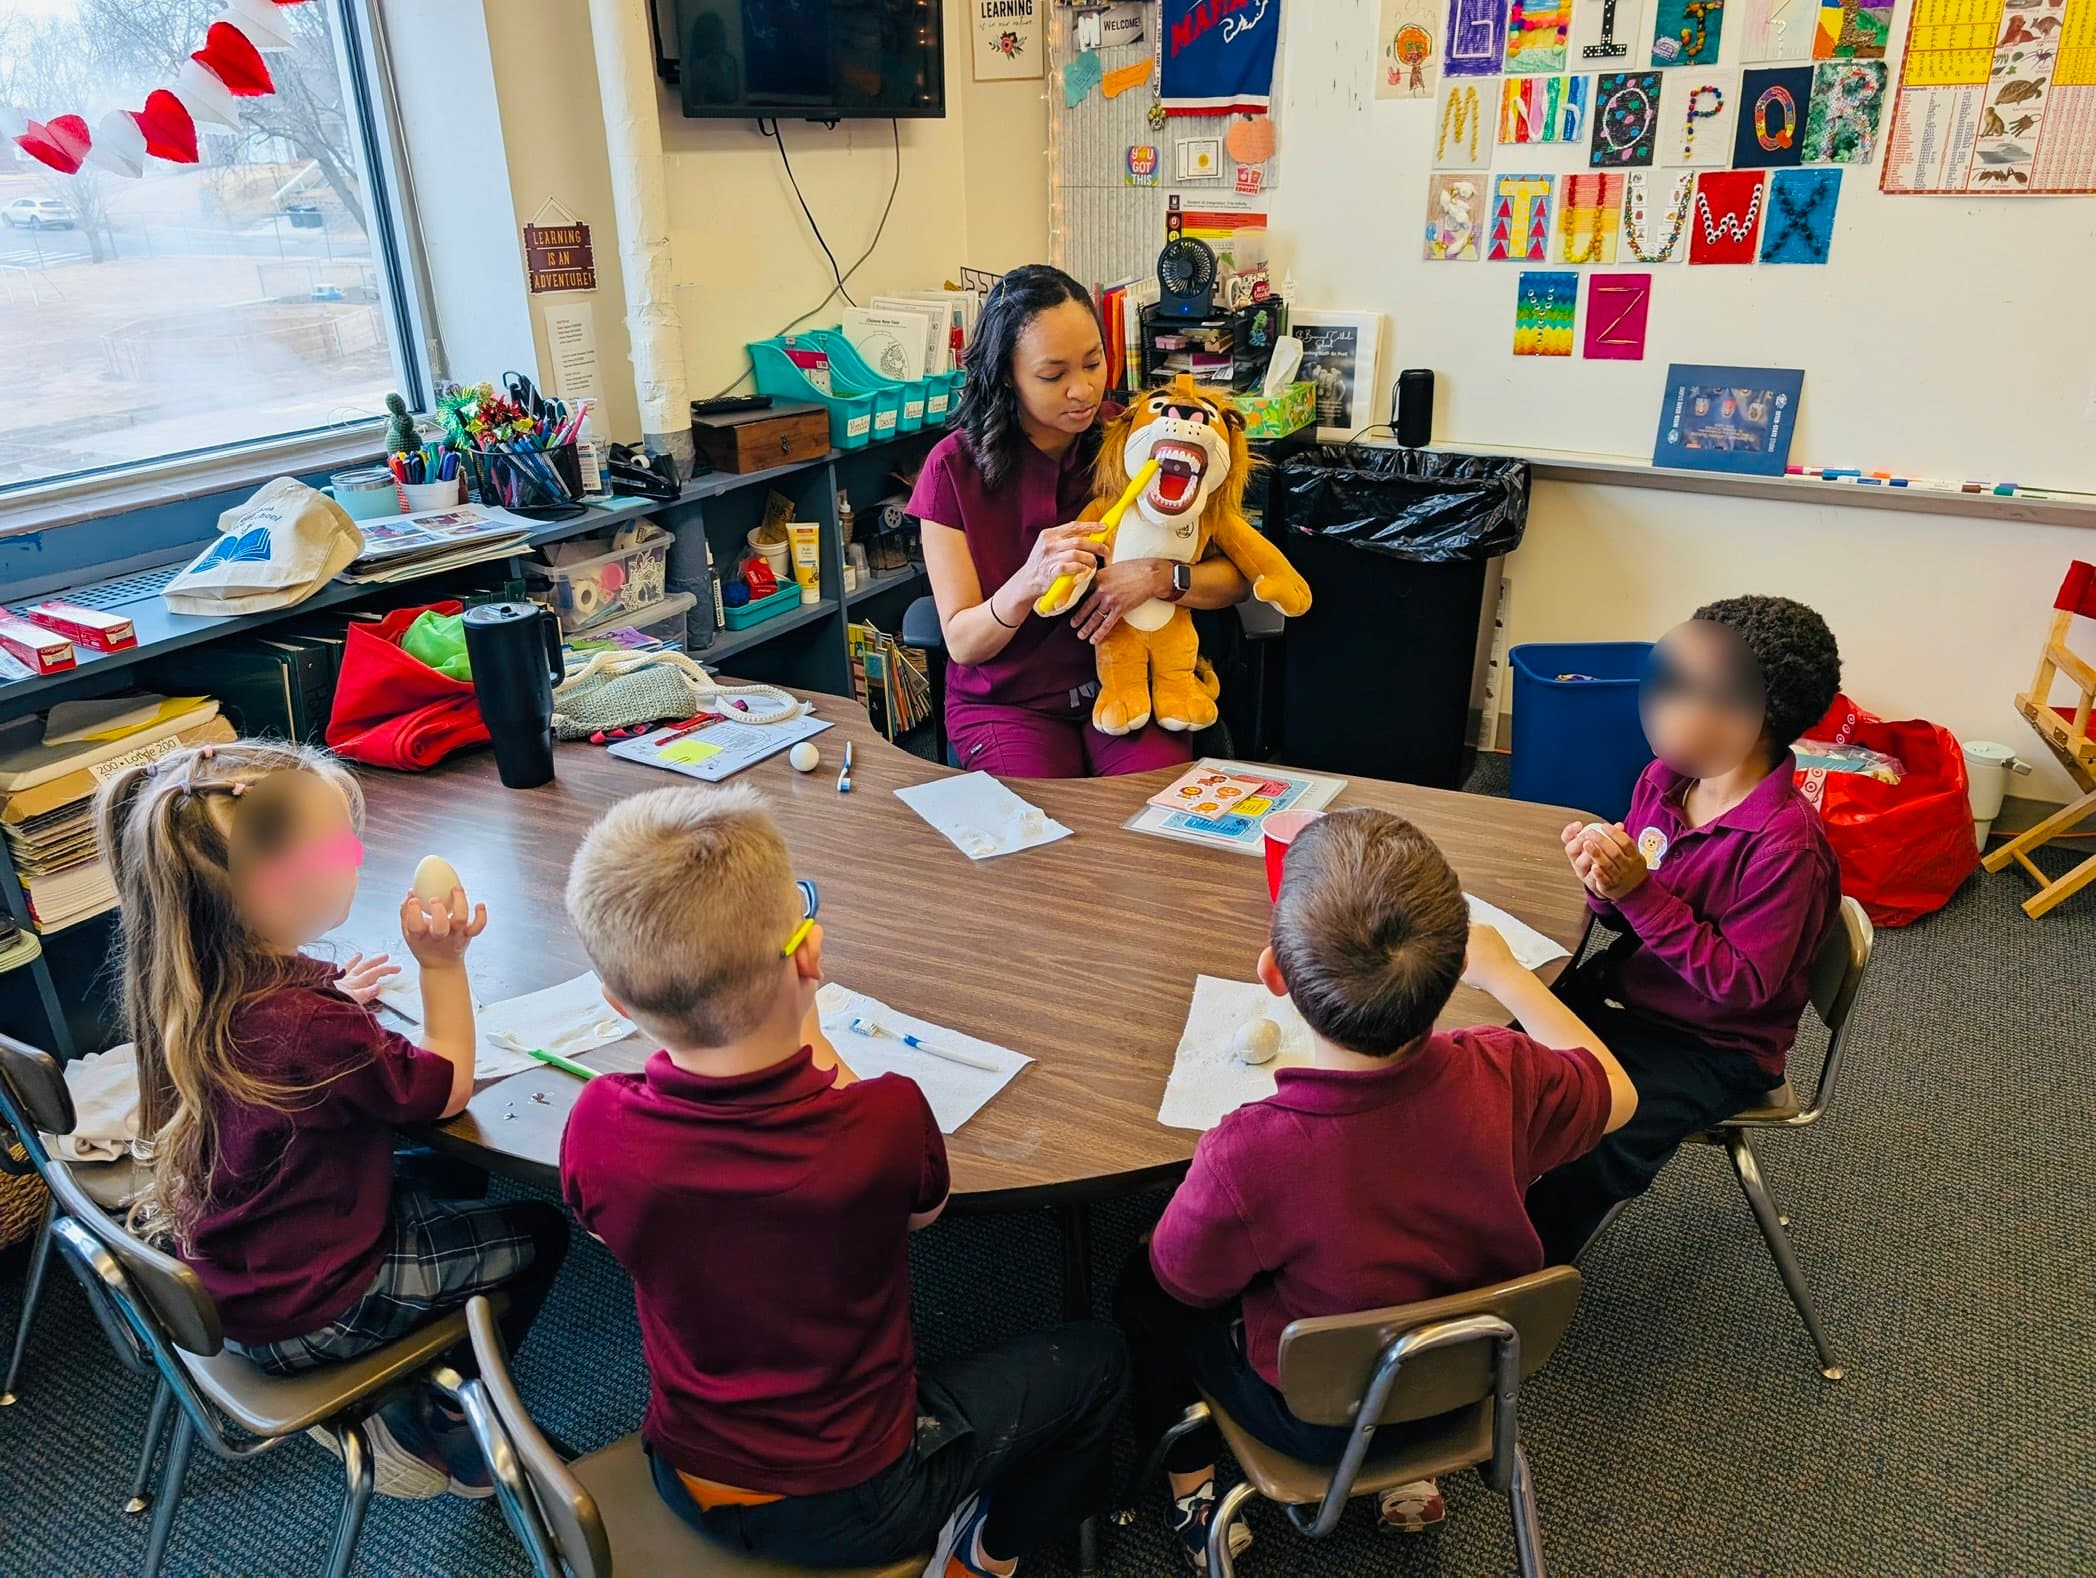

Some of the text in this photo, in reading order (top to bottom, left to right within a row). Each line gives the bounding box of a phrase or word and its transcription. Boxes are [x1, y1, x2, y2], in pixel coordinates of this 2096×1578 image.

[981, 0, 1033, 18] LEARNING
[1103, 17, 1141, 32] WELCOME!
[1436, 85, 1478, 163] M
[1603, 88, 1651, 150] O
[1683, 84, 1724, 160] P
[1754, 85, 1796, 152] Q
[1131, 174, 1152, 186] THIS
[1132, 161, 1152, 173] GOT
[532, 230, 582, 245] LEARNING
[1498, 180, 1550, 259] T
[1696, 183, 1764, 245] W
[1760, 177, 1830, 261] X
[534, 272, 593, 289] ADVENTURE!
[547, 251, 570, 266] IS AN
[1527, 286, 1556, 346] Y
[1595, 287, 1646, 344] Z
[97, 761, 119, 775] 200
[157, 739, 177, 753] 200
